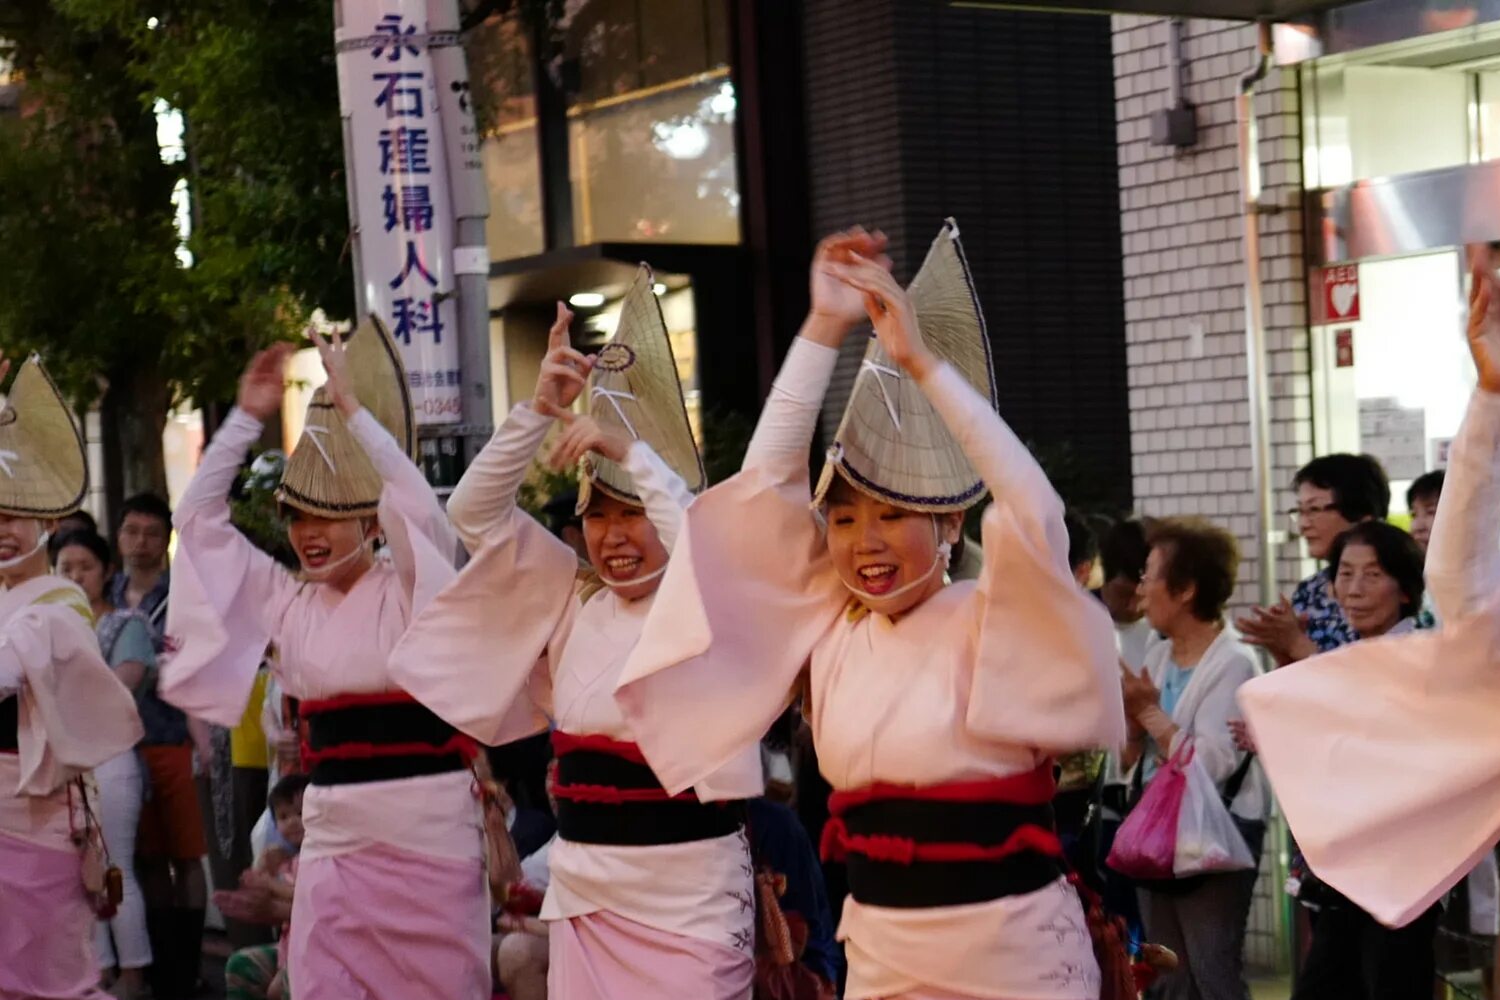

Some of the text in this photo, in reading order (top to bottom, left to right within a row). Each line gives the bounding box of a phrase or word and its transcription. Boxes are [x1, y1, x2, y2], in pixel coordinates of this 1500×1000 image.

[371, 14, 444, 345] 永石産婦人科
[1326, 266, 1357, 283] AED
